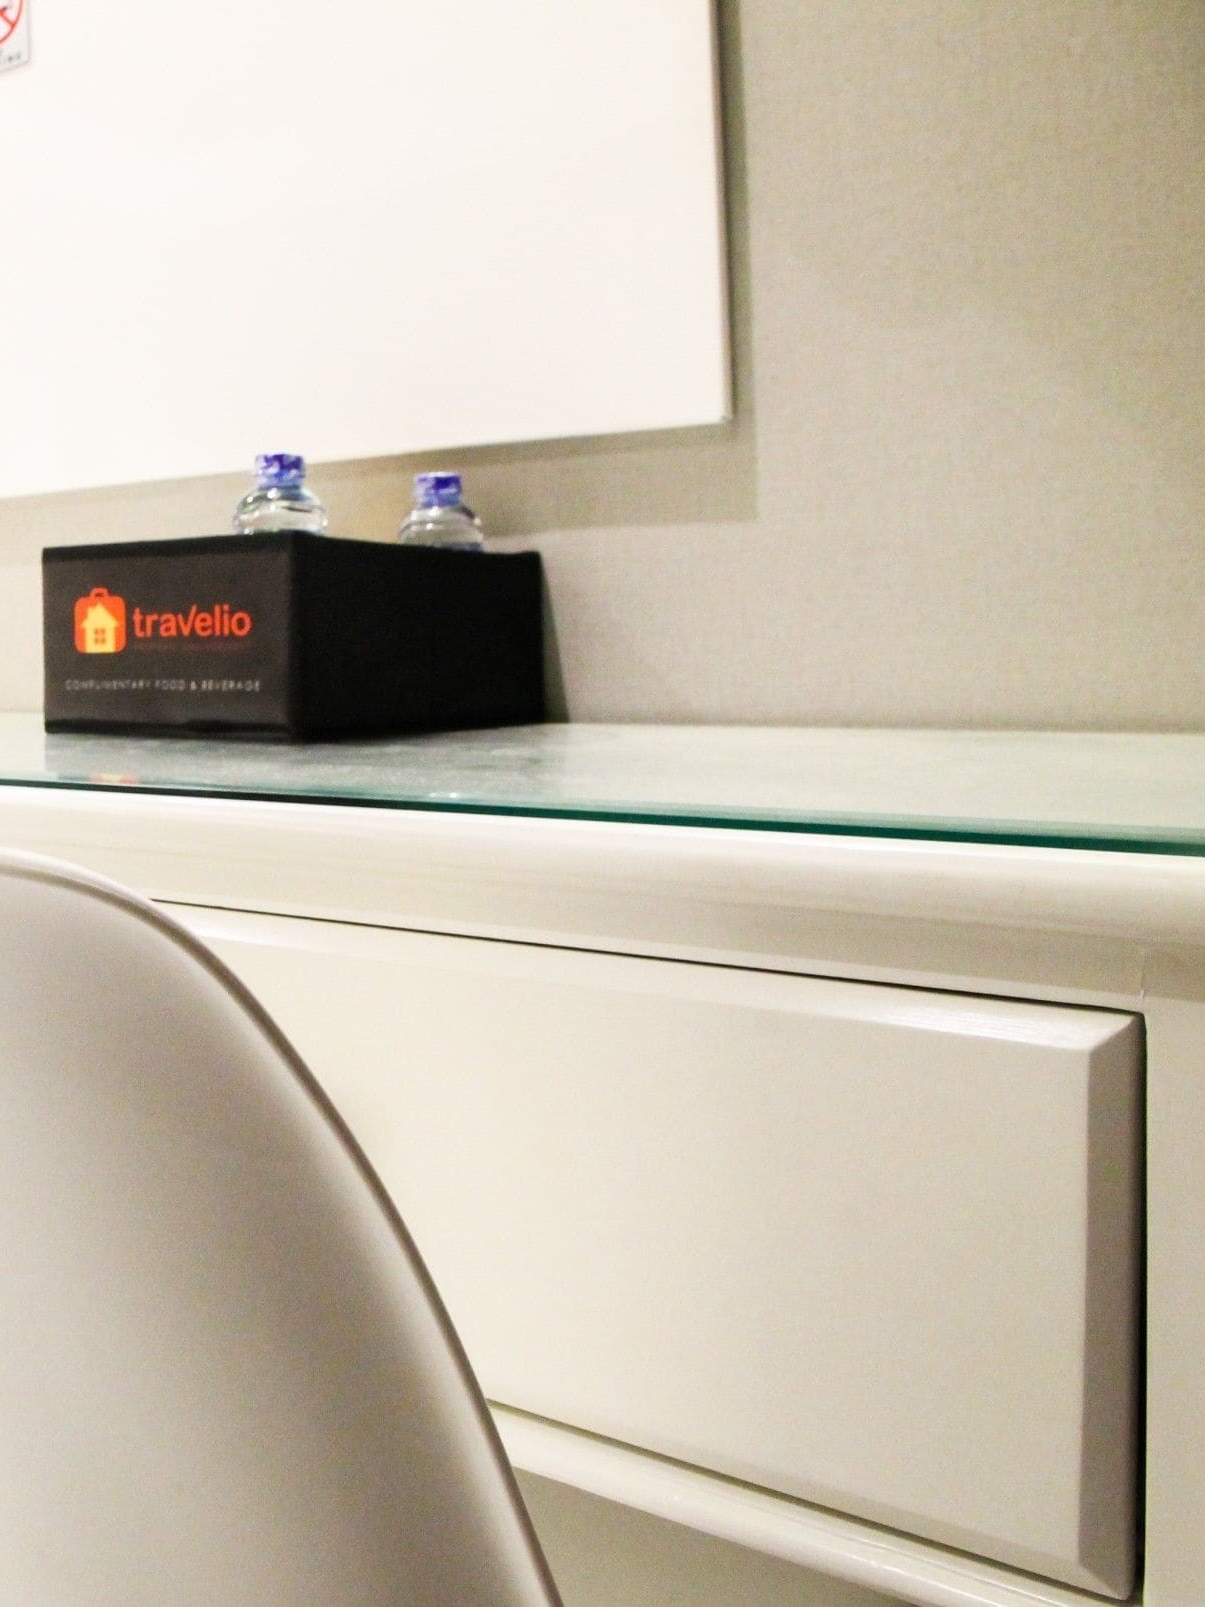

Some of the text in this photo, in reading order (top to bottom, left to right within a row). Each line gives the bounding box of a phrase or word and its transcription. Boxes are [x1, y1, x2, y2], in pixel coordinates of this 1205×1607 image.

[133, 604, 252, 637] travelio
[155, 679, 185, 691] FOOD
[201, 679, 260, 691] BEVERAGE
